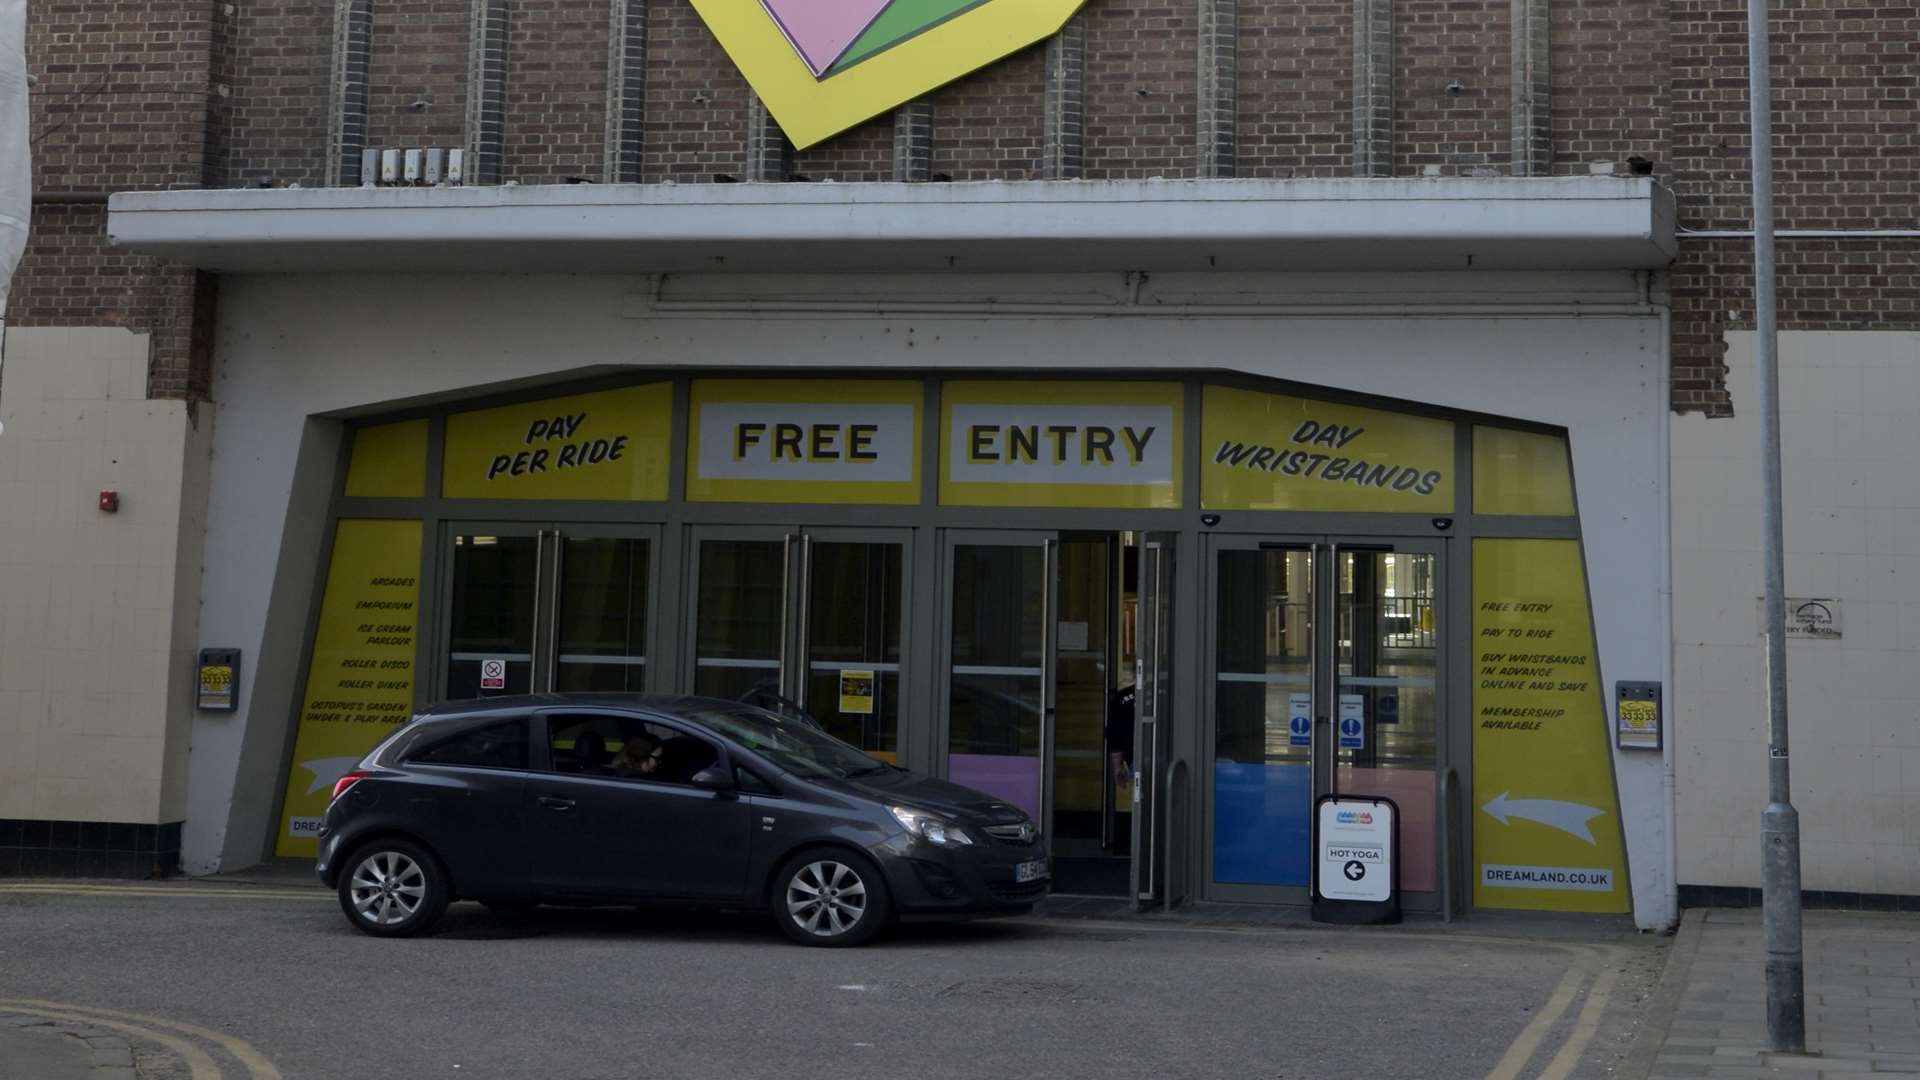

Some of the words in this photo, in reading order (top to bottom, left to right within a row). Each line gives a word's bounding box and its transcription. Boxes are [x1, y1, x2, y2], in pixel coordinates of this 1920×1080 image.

[524, 411, 587, 446] PAY
[1291, 420, 1365, 449] DAY
[733, 423, 878, 463] FREE
[966, 424, 1156, 466] ENTRY
[486, 448, 549, 480] PER
[556, 435, 629, 469] RIDE
[1213, 440, 1441, 496] WRISTBANDS
[370, 578, 415, 587] ARCADES
[356, 601, 413, 610] EMPORIUM
[1480, 602, 1510, 612] FREE
[1513, 603, 1553, 613] ENTRY
[357, 624, 373, 632] ICE
[375, 624, 412, 633] CREAM
[1480, 628, 1505, 637] PAY
[1507, 628, 1522, 638] TO
[1526, 629, 1555, 639] RIDE
[366, 636, 412, 646] PARLOUR
[341, 659, 377, 668] ROLLER
[380, 659, 410, 669] DISCO
[1480, 653, 1506, 662] BUY
[1508, 653, 1587, 665] WRISTBANDS
[1480, 666, 1496, 675] IN
[1499, 667, 1553, 677] ADVANCE
[337, 679, 375, 689] ROLLER
[376, 680, 409, 690] DINER
[1480, 680, 1526, 689] ONLINE
[1529, 681, 1555, 690] AND
[1558, 682, 1588, 691] SAVE
[366, 702, 408, 712] GARDEN
[1480, 706, 1565, 718] MEMBERSHIP
[1480, 720, 1542, 730] AVAILABLE
[1330, 849, 1350, 858] HOT
[1352, 850, 1379, 859] YOGA
[1486, 869, 1608, 885] DREAMLAND.CO.UK
